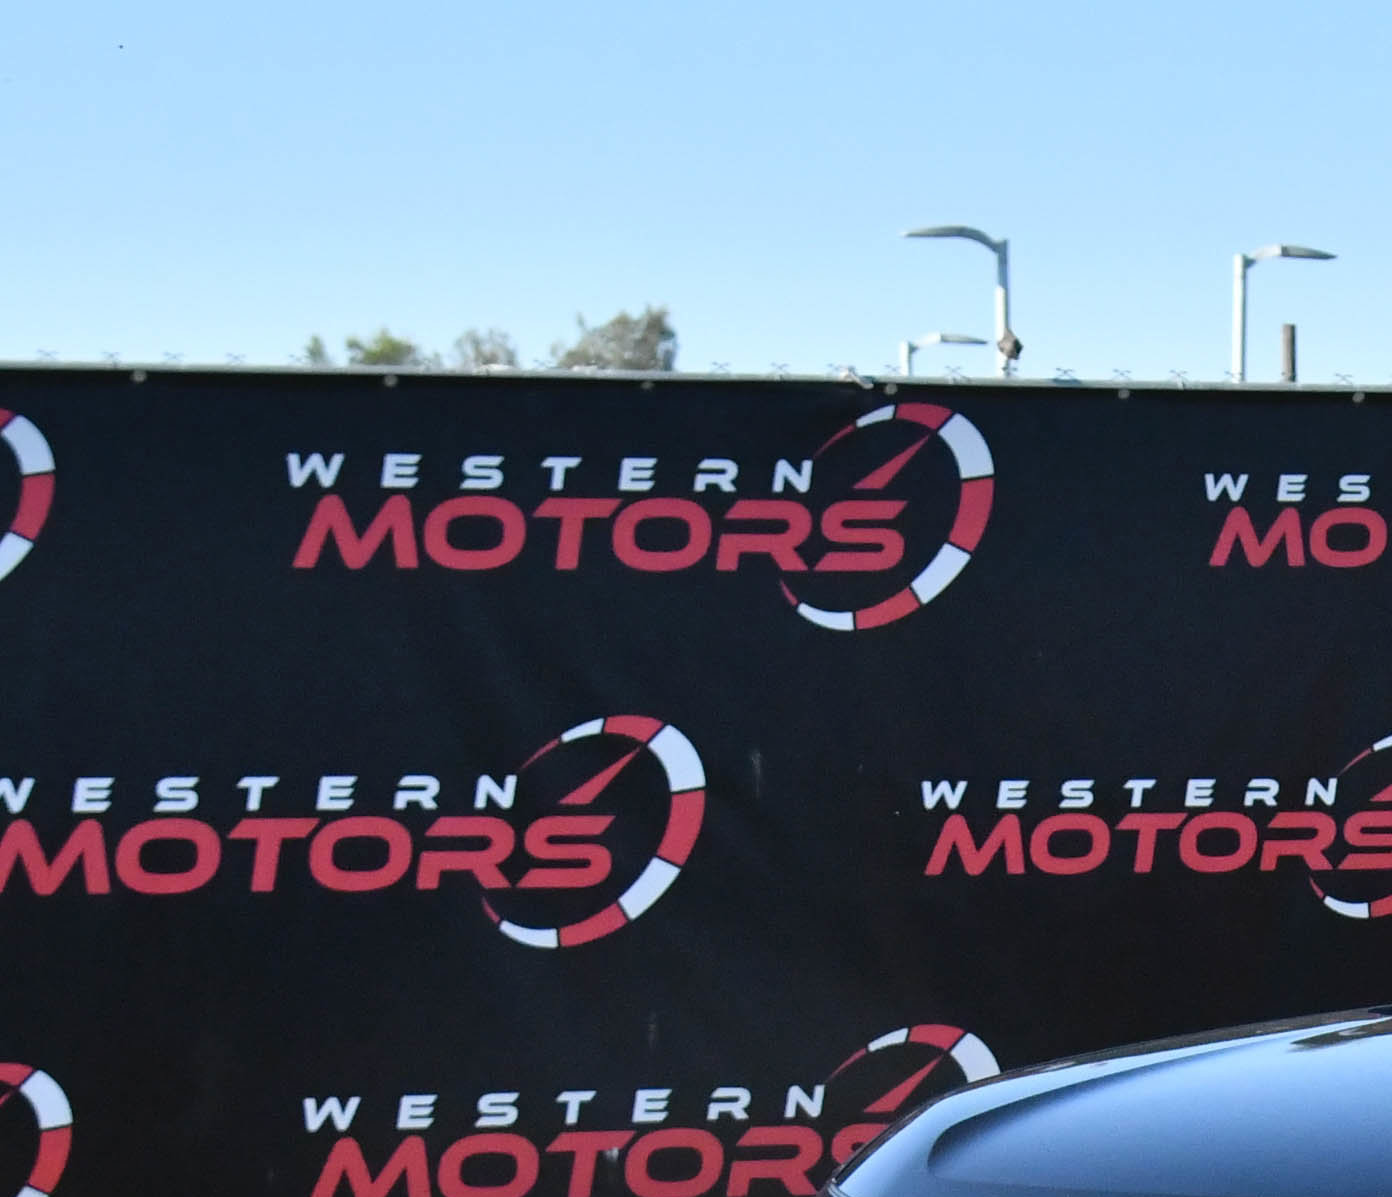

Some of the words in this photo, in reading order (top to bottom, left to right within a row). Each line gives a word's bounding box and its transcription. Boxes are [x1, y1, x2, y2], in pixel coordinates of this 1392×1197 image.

[288, 453, 813, 492] WESTERN
[293, 494, 906, 572] MOTORS
[0, 775, 518, 814] WESTERN
[922, 778, 1338, 809] WESTERN
[0, 816, 614, 897] MOTORS
[304, 1085, 825, 1133] WESTERN
